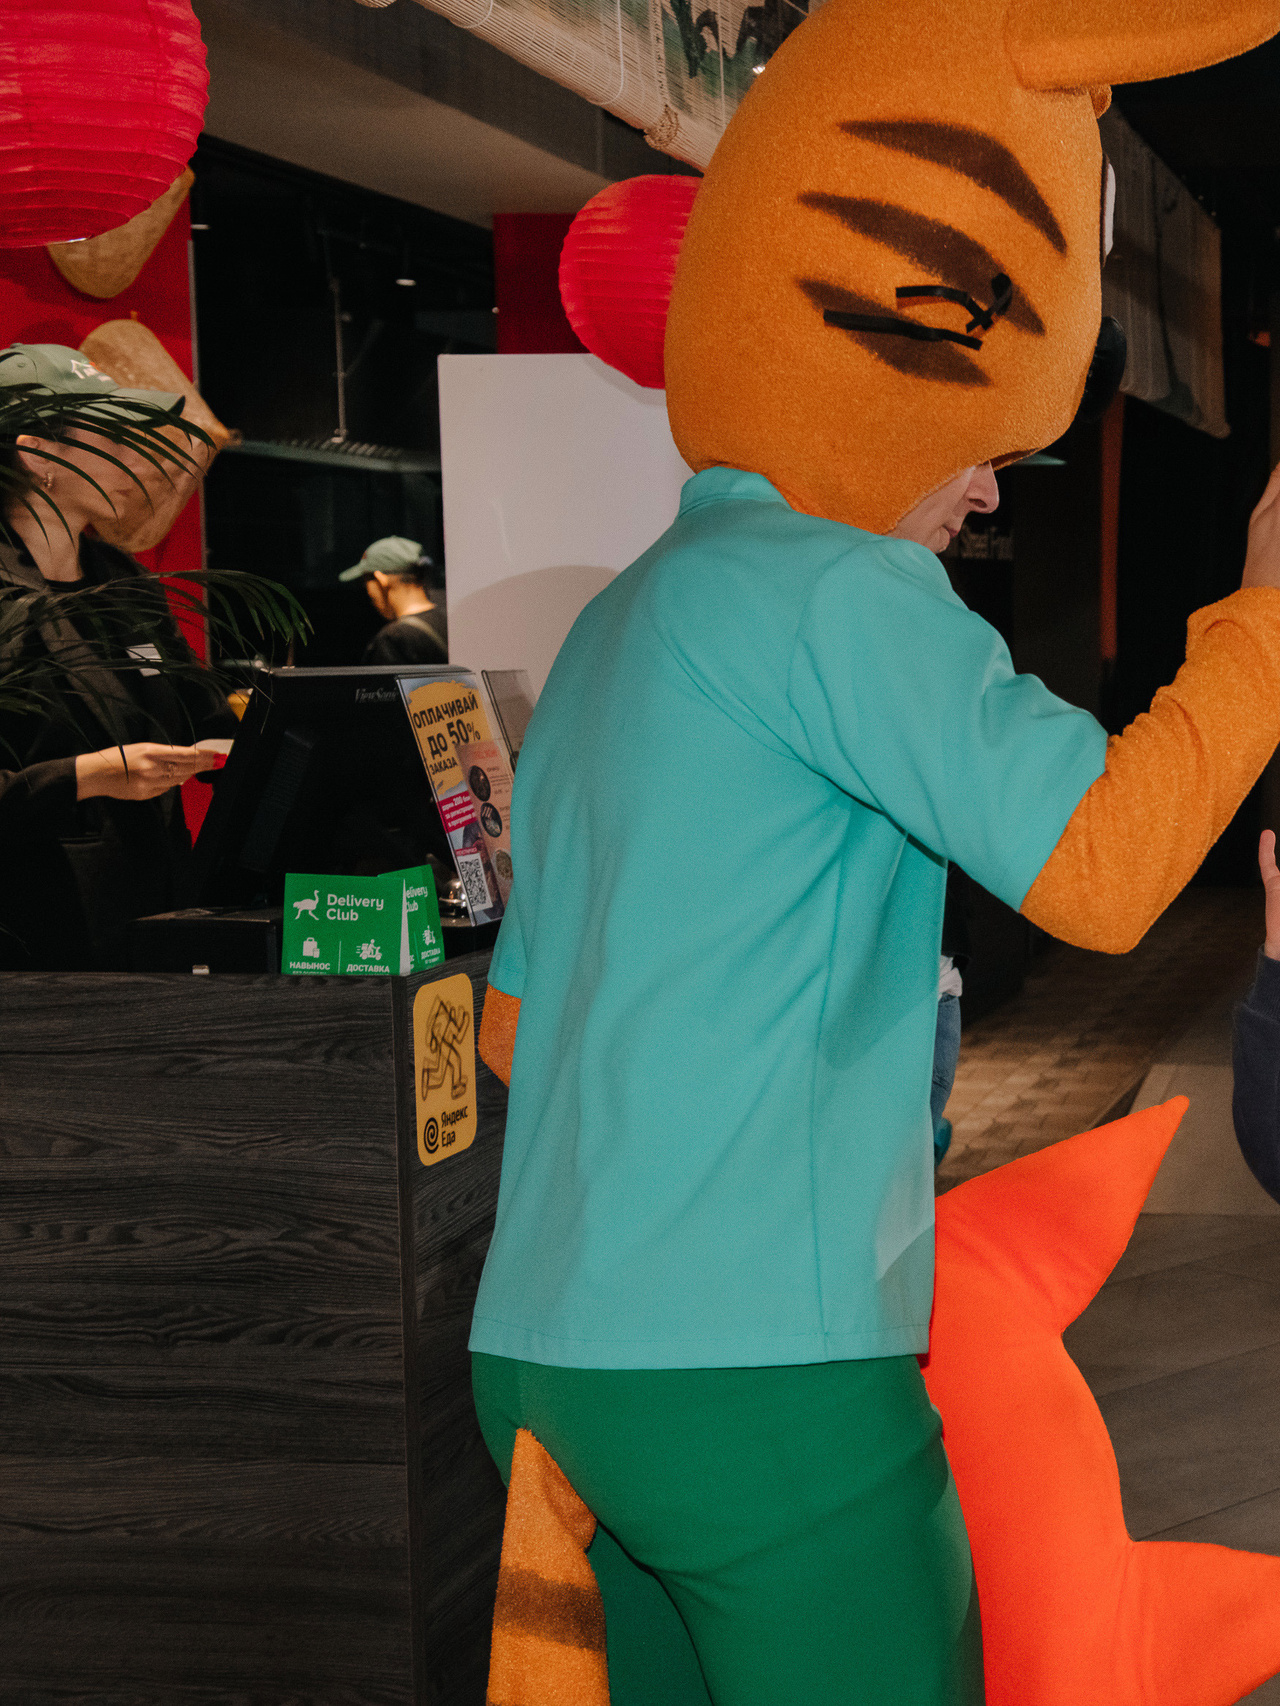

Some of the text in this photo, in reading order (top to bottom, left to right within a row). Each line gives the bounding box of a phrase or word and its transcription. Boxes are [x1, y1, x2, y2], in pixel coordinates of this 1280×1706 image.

[413, 691, 479, 728] ОПЛАЧИВАЙ
[427, 719, 481, 759] ДО 50%
[429, 756, 458, 775] ЗАКАЗА
[406, 886, 428, 898] elivery
[327, 894, 384, 911] Delivery
[326, 908, 359, 921] Club
[289, 961, 331, 971] НАВЫНОС
[346, 964, 390, 973] ДОСТАВКА
[441, 1106, 468, 1128] Яндекс
[441, 1130, 456, 1147] Еда
